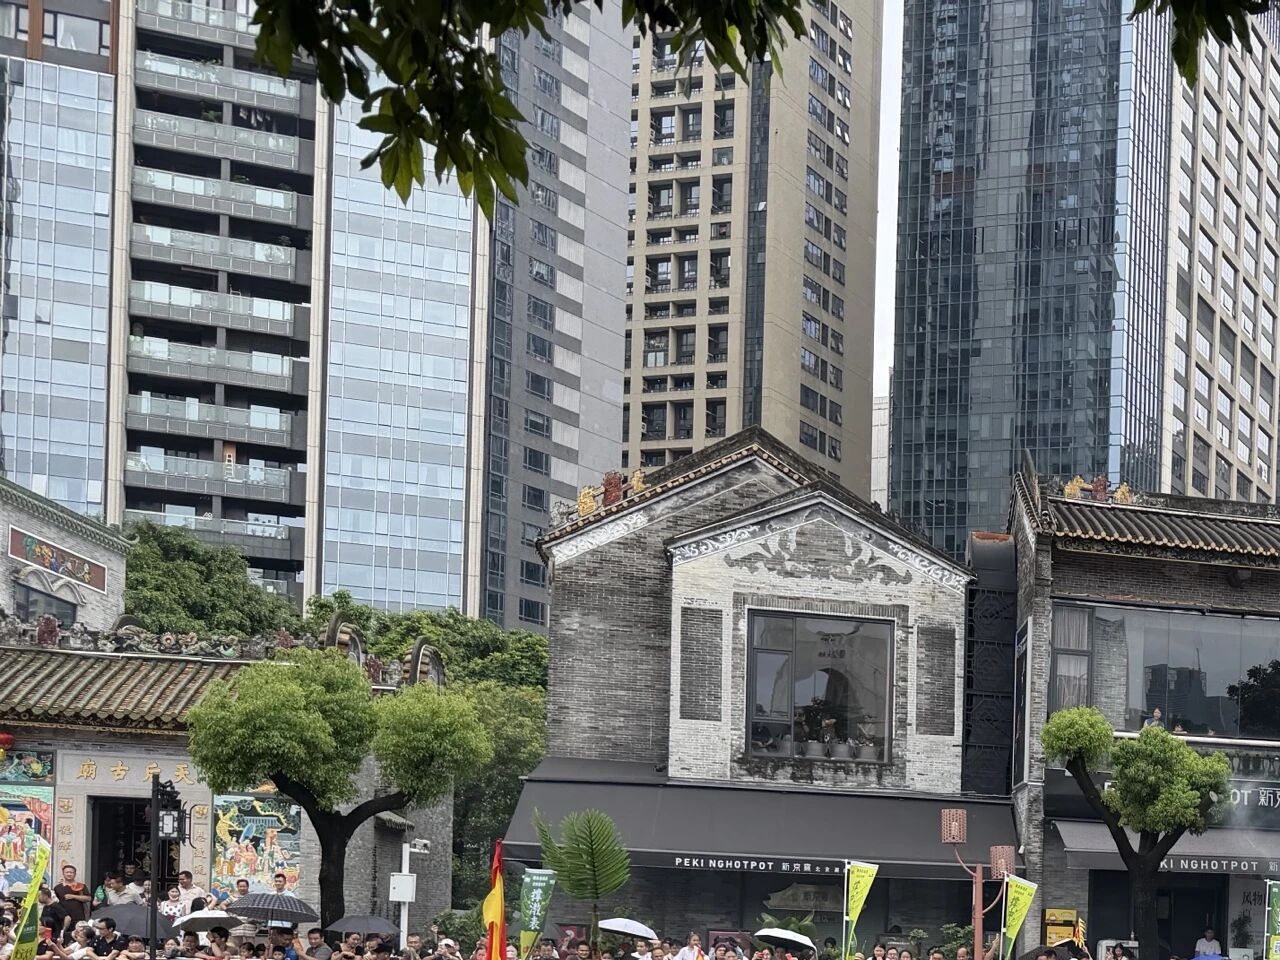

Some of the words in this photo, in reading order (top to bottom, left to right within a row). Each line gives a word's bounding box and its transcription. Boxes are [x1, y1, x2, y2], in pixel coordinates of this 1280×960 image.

[675, 857, 705, 868] PEKI
[708, 859, 774, 871] NGHOTPOT
[1180, 860, 1259, 872] NGHOTPOT
